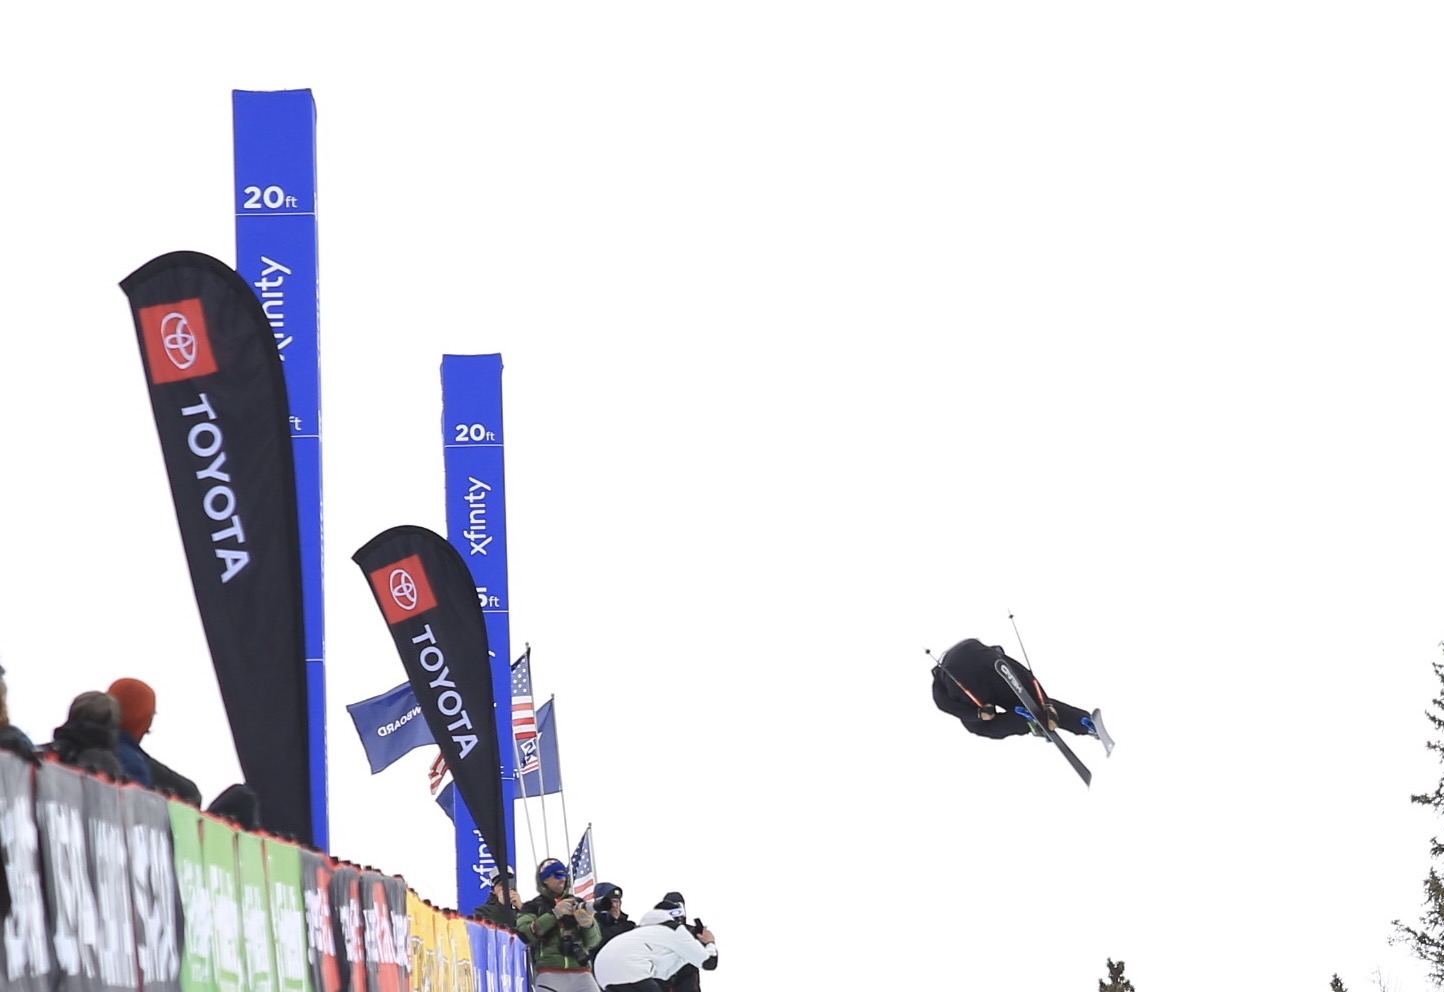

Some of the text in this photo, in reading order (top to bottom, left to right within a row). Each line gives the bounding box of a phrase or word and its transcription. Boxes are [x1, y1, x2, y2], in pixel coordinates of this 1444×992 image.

[181, 393, 250, 582] TOYOTA
[463, 476, 493, 555] xfinity
[476, 587, 500, 607] 5ft
[411, 624, 479, 760] TOYOTA
